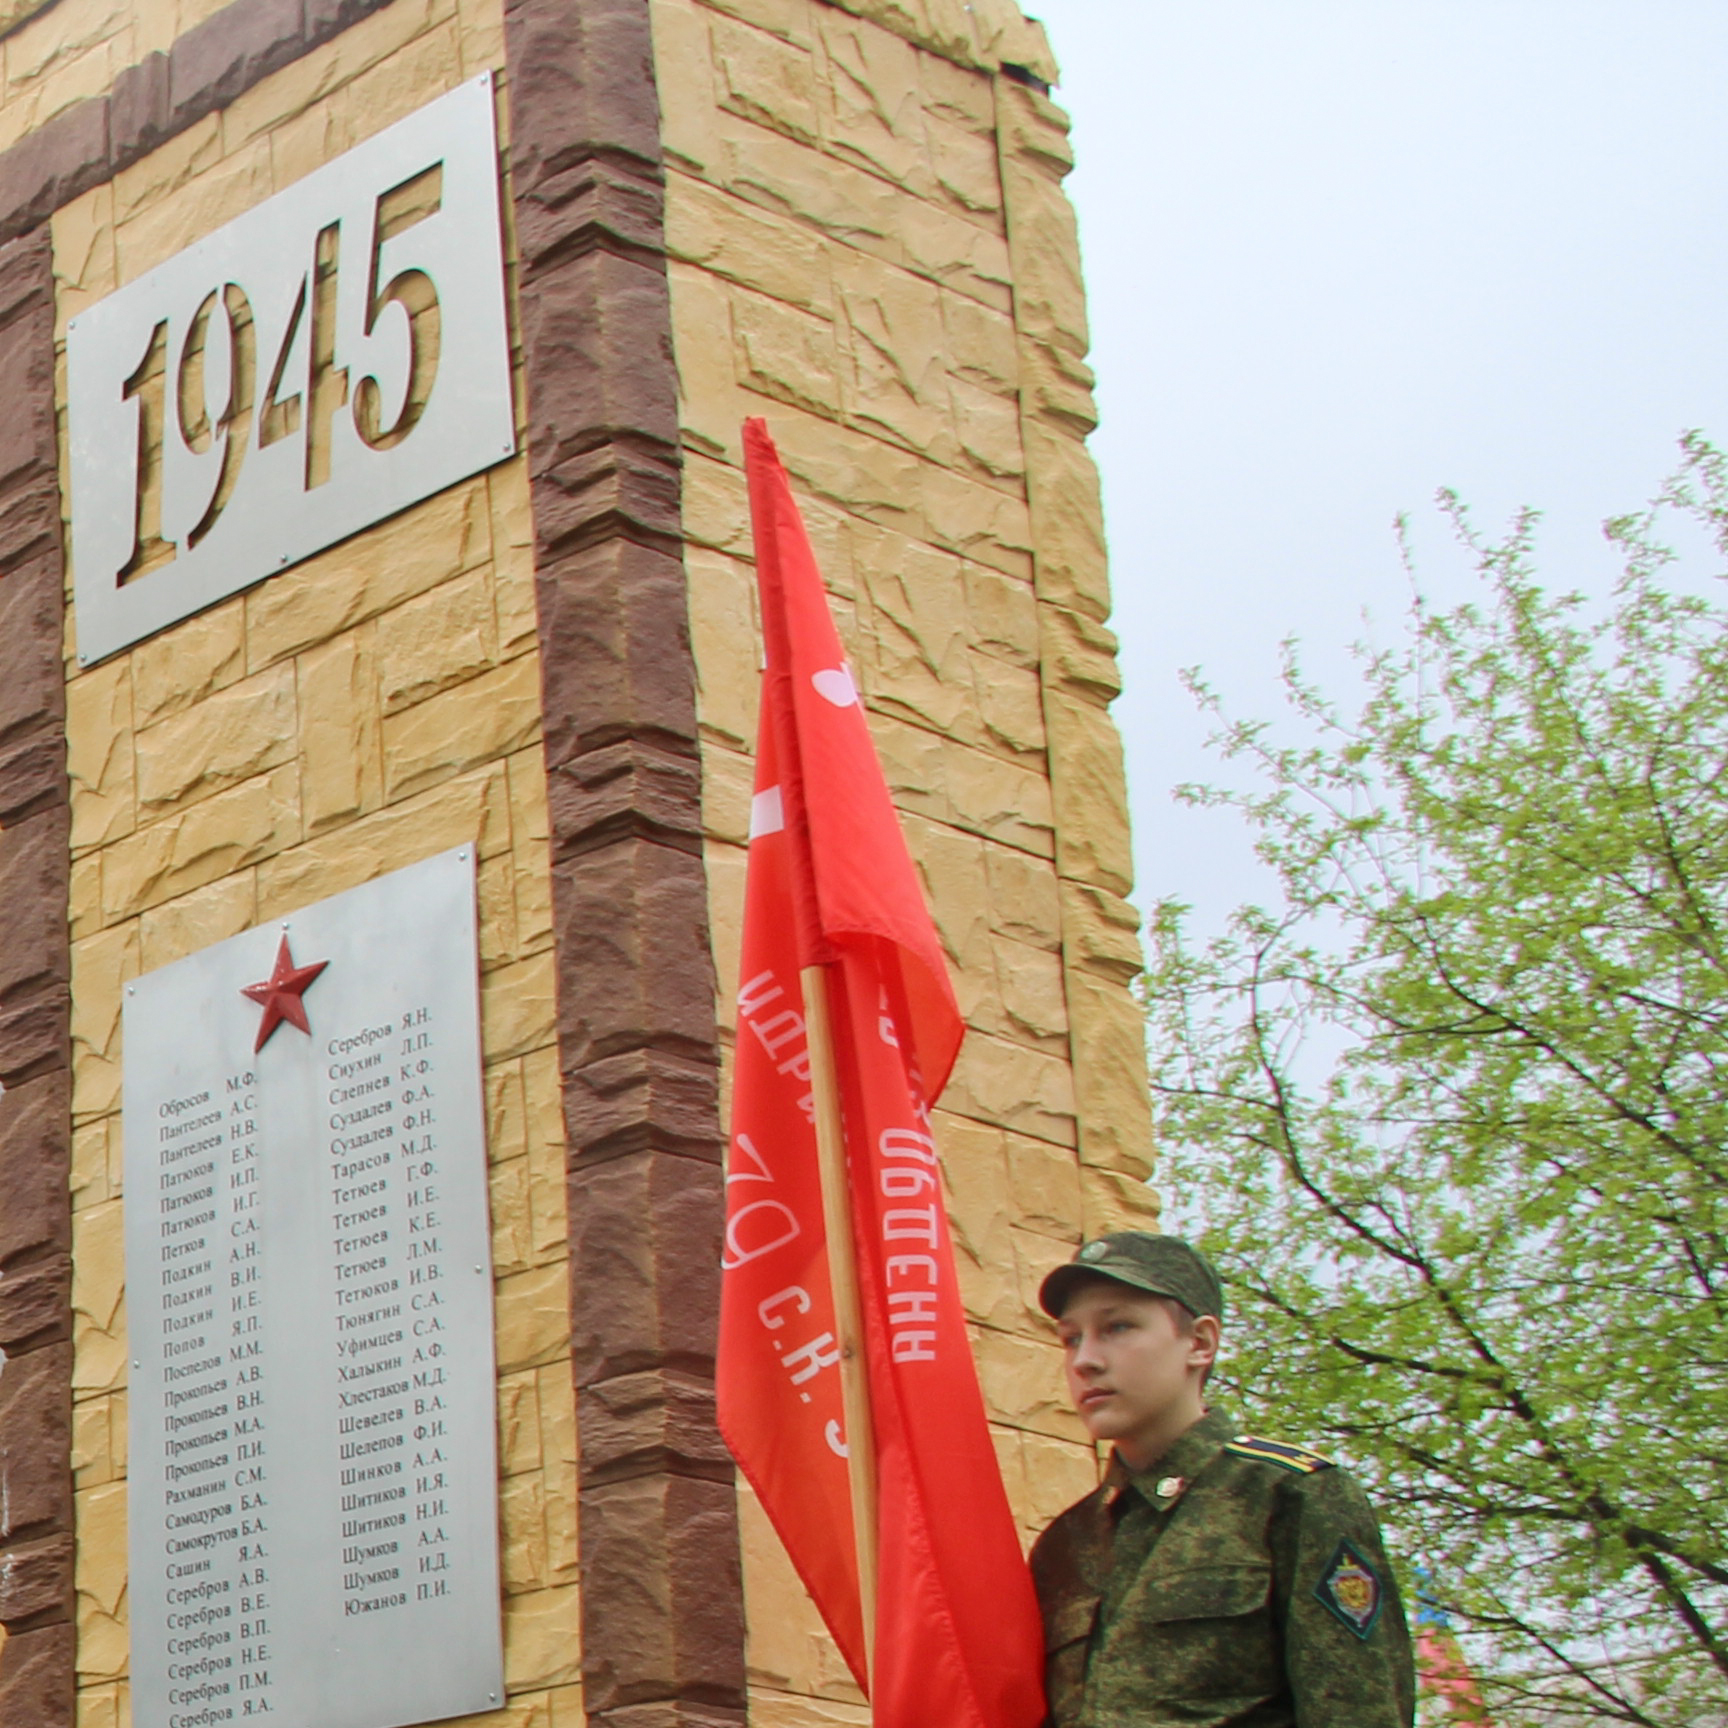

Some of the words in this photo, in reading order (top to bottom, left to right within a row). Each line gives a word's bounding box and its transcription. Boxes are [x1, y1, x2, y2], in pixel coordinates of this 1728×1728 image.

[115, 159, 444, 588] 1945
[328, 1025, 392, 1056] Серебров
[402, 1007, 432, 1030] Я.Н.
[400, 1033, 433, 1056] Л.П.
[159, 1092, 209, 1118] Обросов
[226, 1070, 258, 1093] М.Ф.
[329, 1076, 390, 1105] Слепнев
[400, 1060, 433, 1081] К.Ф.
[160, 1111, 222, 1142] Пантелеев
[230, 1094, 258, 1116] А.С.
[330, 1101, 392, 1132] Суздалев
[401, 1085, 434, 1105] Ф.А.
[160, 1135, 222, 1166] Пантелеев
[231, 1119, 258, 1140] Н.В.
[330, 1126, 393, 1157] Суздалев
[402, 1108, 435, 1130] Ф.Н.
[160, 1162, 214, 1190] Патюков
[232, 1143, 260, 1164] Е.К.
[331, 1153, 390, 1180] Тарасов
[401, 1134, 437, 1158] М.Д.
[161, 1187, 213, 1214] Патюков
[231, 1167, 259, 1189] И.П.
[332, 1180, 386, 1205] Тетюев
[407, 1161, 437, 1182] Г.Ф.
[161, 1210, 215, 1237] Патюков
[234, 1191, 260, 1213] И.Г.
[332, 1205, 387, 1230] Тетюев
[408, 1186, 440, 1208] И.Е.
[161, 1238, 205, 1262] Петков
[231, 1218, 260, 1237] С.А.
[333, 1231, 388, 1256] Тетюев
[409, 1212, 440, 1233] К.Е.
[162, 1260, 211, 1286] Подкин
[229, 1241, 261, 1263] А.Н.
[334, 1257, 387, 1281] Тетюев
[406, 1237, 442, 1260] Л.М.
[163, 1285, 212, 1310] Подкин
[231, 1266, 261, 1287] В.И.
[335, 1279, 399, 1306] Тетюков
[410, 1264, 443, 1285] И.В.
[163, 1309, 213, 1334] Подкин
[232, 1291, 261, 1312] И.Е.
[336, 1304, 401, 1331] Тюнягин
[411, 1291, 444, 1311] С.А.
[163, 1336, 205, 1358] Попов
[232, 1316, 263, 1337] Я.П.
[337, 1330, 403, 1358] Уфимцев
[413, 1317, 445, 1337] С.А.
[164, 1356, 221, 1383] Поспелов
[230, 1340, 263, 1363] М.М.
[338, 1357, 401, 1383] Халыкин
[412, 1343, 446, 1363] А.Ф.
[165, 1379, 227, 1409] Прокопьев
[236, 1365, 264, 1386] А.В.
[338, 1381, 409, 1409] Хлестаков
[413, 1367, 446, 1390] М.Д.
[165, 1404, 228, 1433] Прокопьев
[237, 1390, 264, 1411] В.Н.
[339, 1408, 403, 1434] Шевелев
[414, 1395, 446, 1415] В.А.
[165, 1429, 228, 1458] Прокопьев
[234, 1416, 265, 1437] М.А.
[340, 1435, 403, 1460] Шелепов
[413, 1420, 447, 1441] Ф.И.
[165, 1454, 229, 1483] Прокопьев
[237, 1440, 265, 1461] П.И.
[341, 1462, 401, 1486] Шинков
[413, 1448, 447, 1468] А.А.
[166, 1480, 226, 1506] Рахманин
[235, 1466, 266, 1487] С.М.
[341, 1487, 406, 1512] Шитиков
[416, 1473, 448, 1494] И.Я.
[165, 1504, 232, 1530] Самодуров
[240, 1492, 267, 1511] Б.А.
[342, 1513, 406, 1538] Шитиков
[416, 1499, 448, 1520] Н.И.
[166, 1528, 238, 1555] Самокрутов
[241, 1517, 268, 1537] Б.А.
[343, 1541, 398, 1565] Шумков
[418, 1527, 449, 1547] А.А.
[166, 1560, 211, 1579] Сашин
[238, 1543, 268, 1563] Я.А.
[344, 1568, 399, 1591] Шумков
[419, 1552, 450, 1573] И.Д.
[166, 1580, 230, 1605] Серебров
[239, 1568, 269, 1590] А.В.
[345, 1593, 406, 1616] Южанов
[417, 1579, 450, 1600] П.И.
[167, 1606, 231, 1631] Серебров
[241, 1593, 270, 1613] В.Е.
[168, 1631, 230, 1656] Серебров
[240, 1619, 270, 1639] В.П.
[168, 1657, 232, 1681] Серебров
[241, 1645, 271, 1665] Н.Е.
[169, 1682, 230, 1706] Серебров
[239, 1670, 272, 1690] П.М.
[243, 1697, 273, 1716] Я.А.
